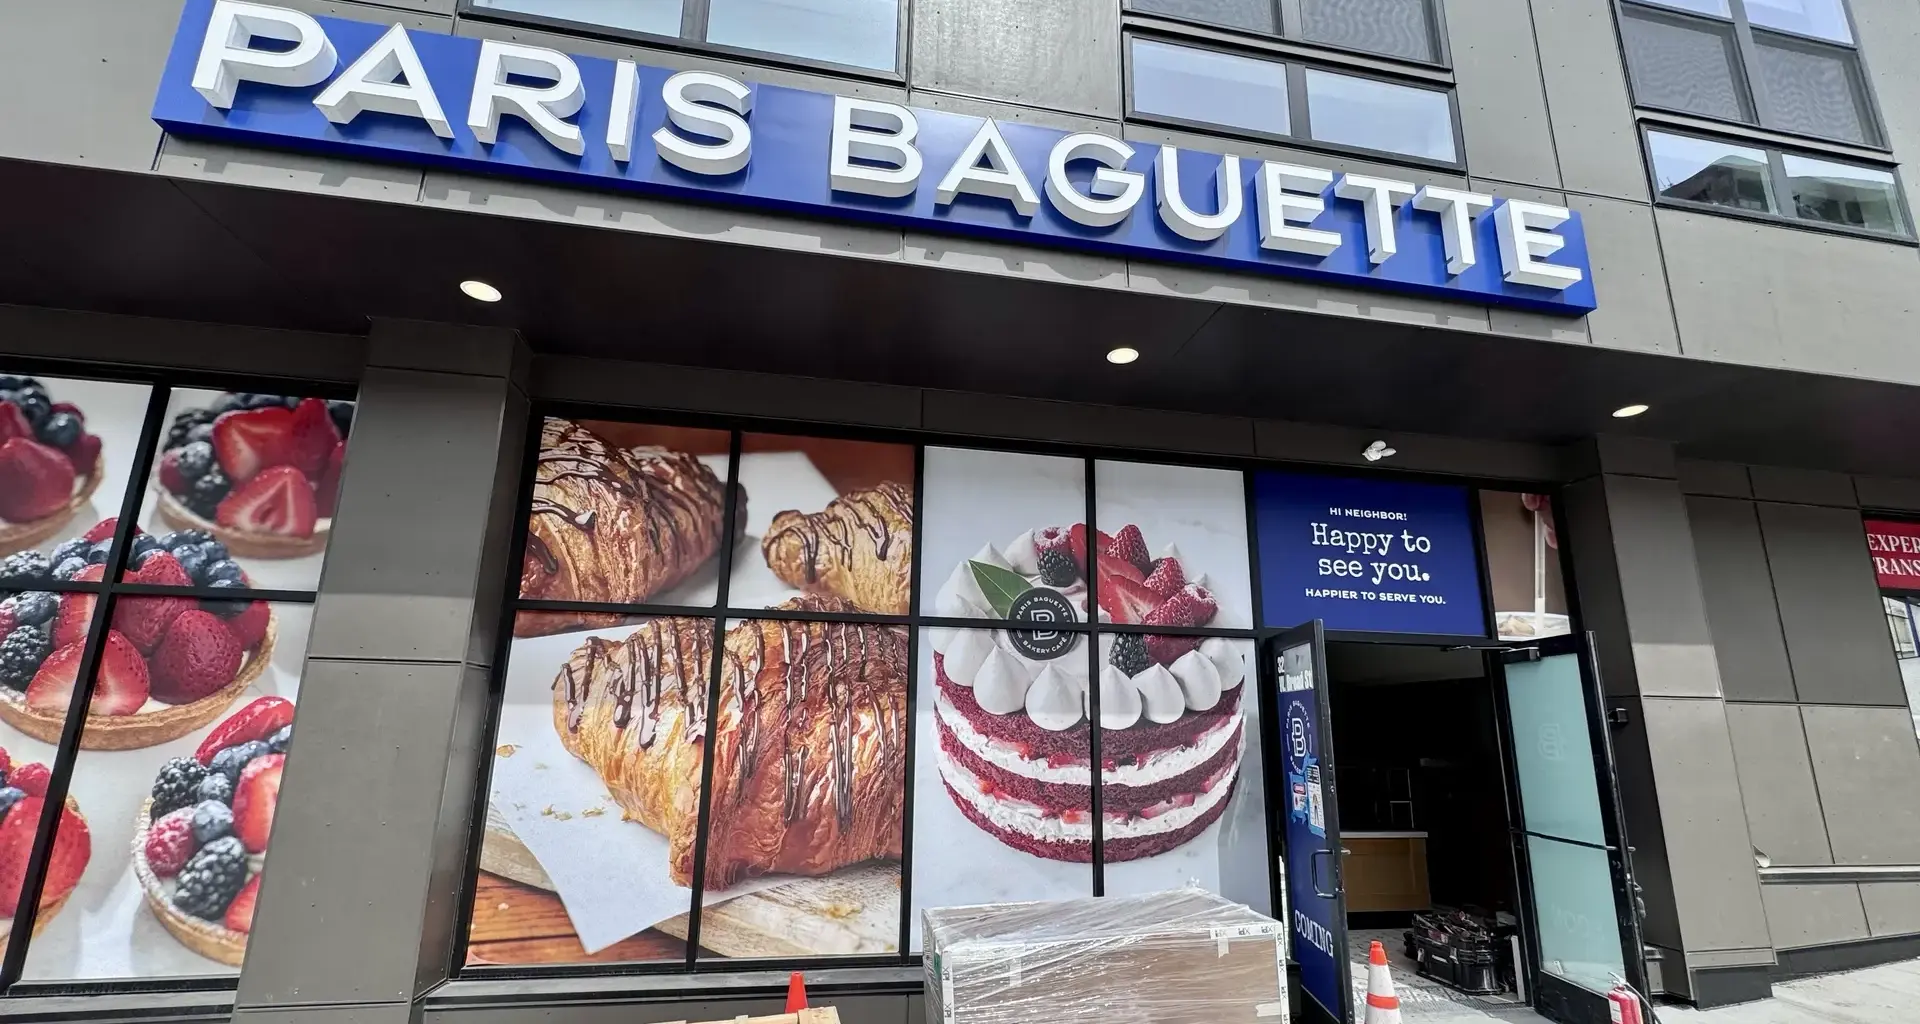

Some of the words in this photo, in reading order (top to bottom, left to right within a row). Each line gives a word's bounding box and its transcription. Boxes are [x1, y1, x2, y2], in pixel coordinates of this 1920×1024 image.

[191, 0, 753, 176] PARIS
[830, 96, 1583, 290] BAGUETTE
[1329, 507, 1342, 517] HI
[1345, 508, 1407, 521] NEIGHBOR!
[1311, 522, 1393, 556] Happy
[1401, 529, 1431, 554] to
[1318, 557, 1363, 578] see
[1370, 561, 1431, 585] you.
[1016, 600, 1032, 620] PARIS
[1033, 596, 1069, 618] BAGUETTE
[1305, 588, 1358, 600] HAPPIER
[1361, 591, 1376, 601] TO
[1379, 592, 1416, 603] SERVE
[1419, 594, 1446, 605] YOU.
[1022, 640, 1050, 654] BAKERY
[1294, 909, 1334, 959] COMING
